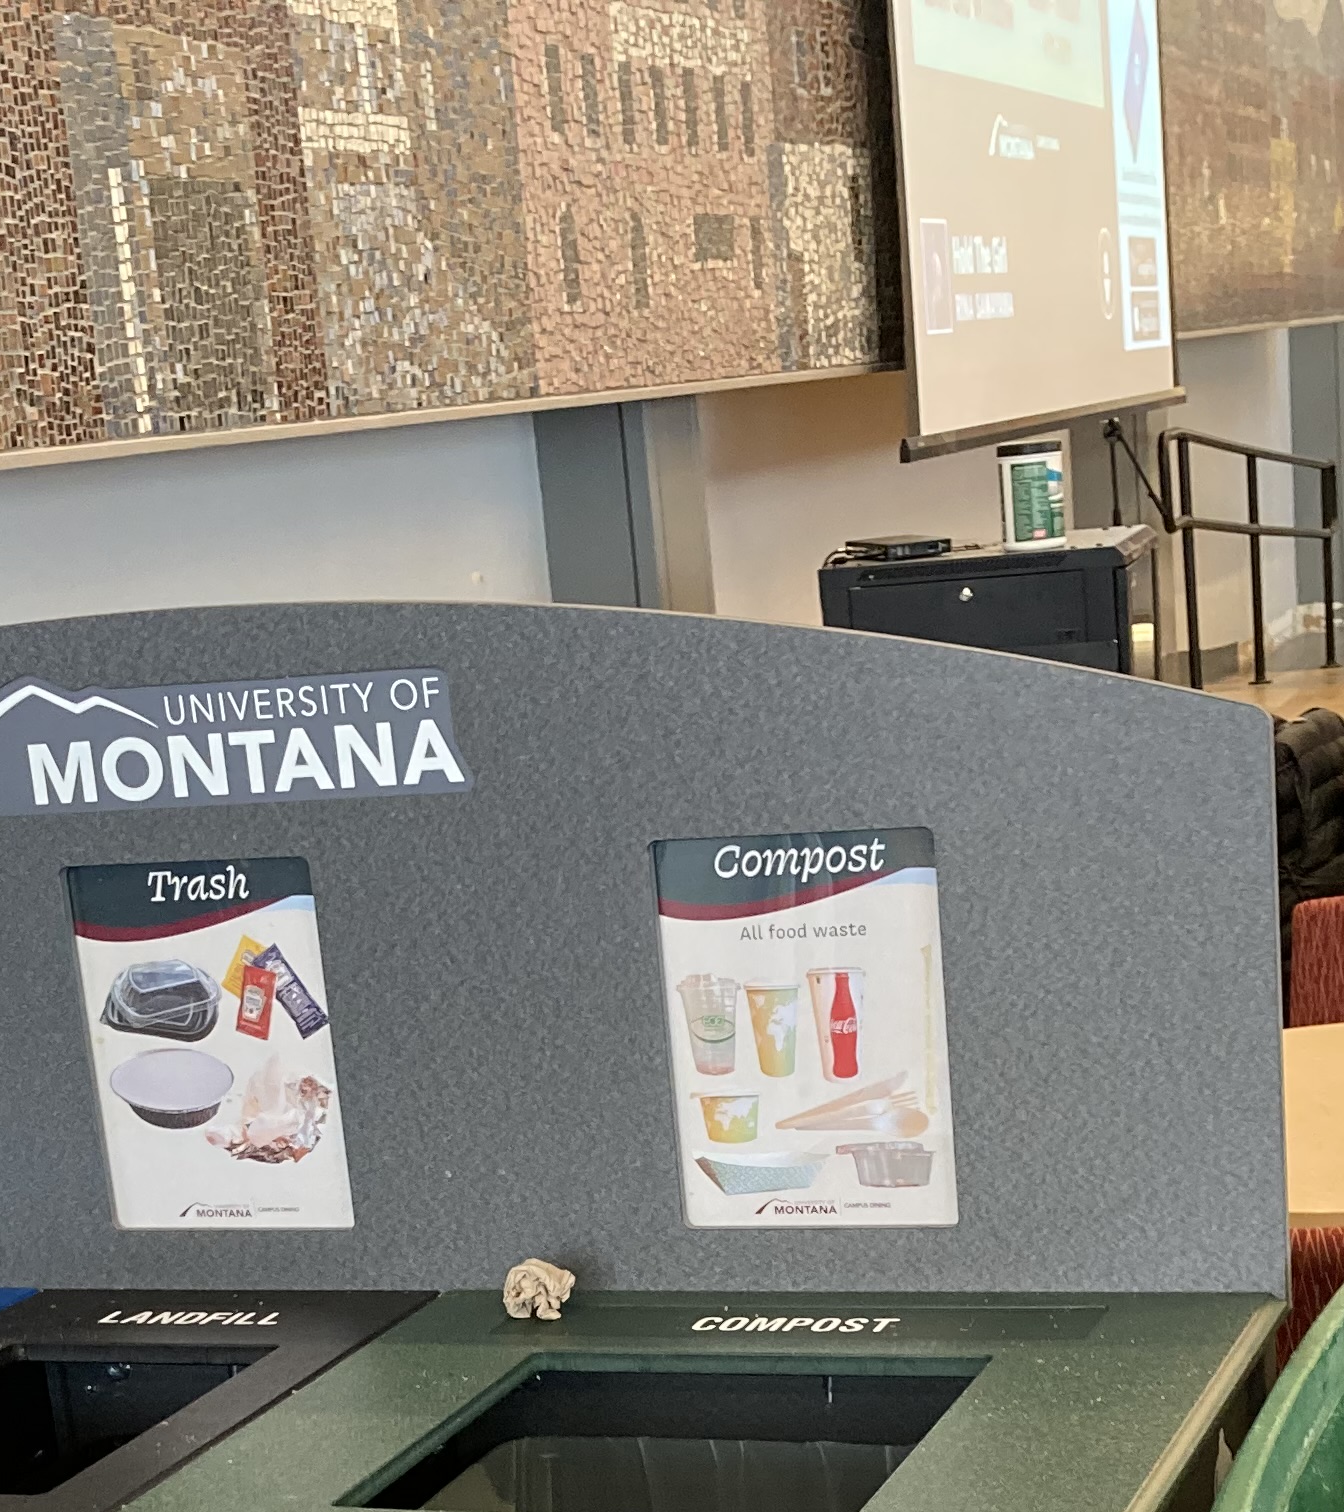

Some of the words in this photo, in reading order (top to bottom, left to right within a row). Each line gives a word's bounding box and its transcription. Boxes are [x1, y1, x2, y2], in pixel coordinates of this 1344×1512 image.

[163, 682, 374, 726] UNIVERSITY
[389, 676, 440, 711] OF
[27, 719, 465, 806] MONTANA
[714, 837, 886, 883] Compost
[147, 864, 250, 902] Trash
[740, 924, 763, 941] All
[768, 922, 807, 940] food
[812, 923, 867, 939] waste
[196, 1208, 253, 1218] MONTANA
[774, 1205, 838, 1215] MONTANA
[97, 1310, 280, 1325] LANDFILL
[691, 1316, 901, 1333] COMPOST
